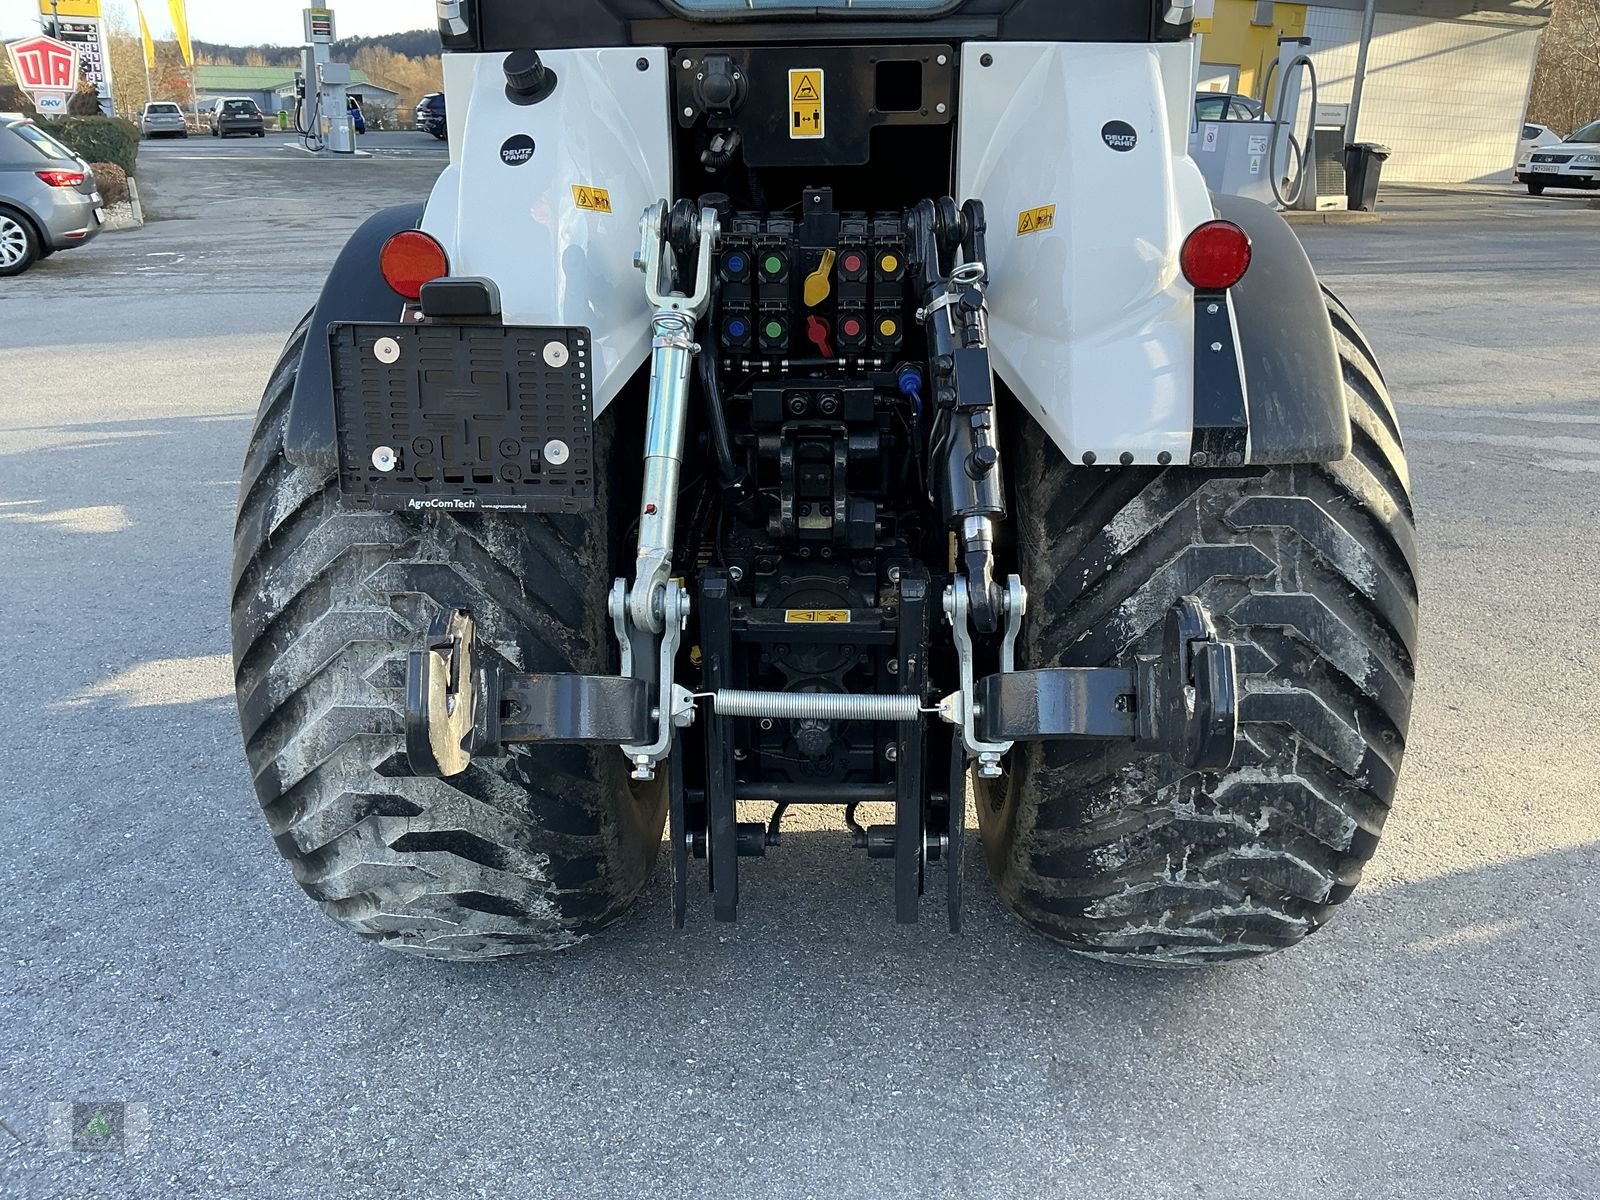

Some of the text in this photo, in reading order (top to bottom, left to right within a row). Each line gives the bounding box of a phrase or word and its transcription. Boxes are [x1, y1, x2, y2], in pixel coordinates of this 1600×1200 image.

[16, 41, 71, 86] UTA
[40, 99, 61, 107] DKV
[1105, 134, 1136, 142] DEUTZ
[502, 147, 533, 156] DEUTZ
[505, 153, 529, 161] FAHR
[408, 498, 475, 510] AgroComTech
